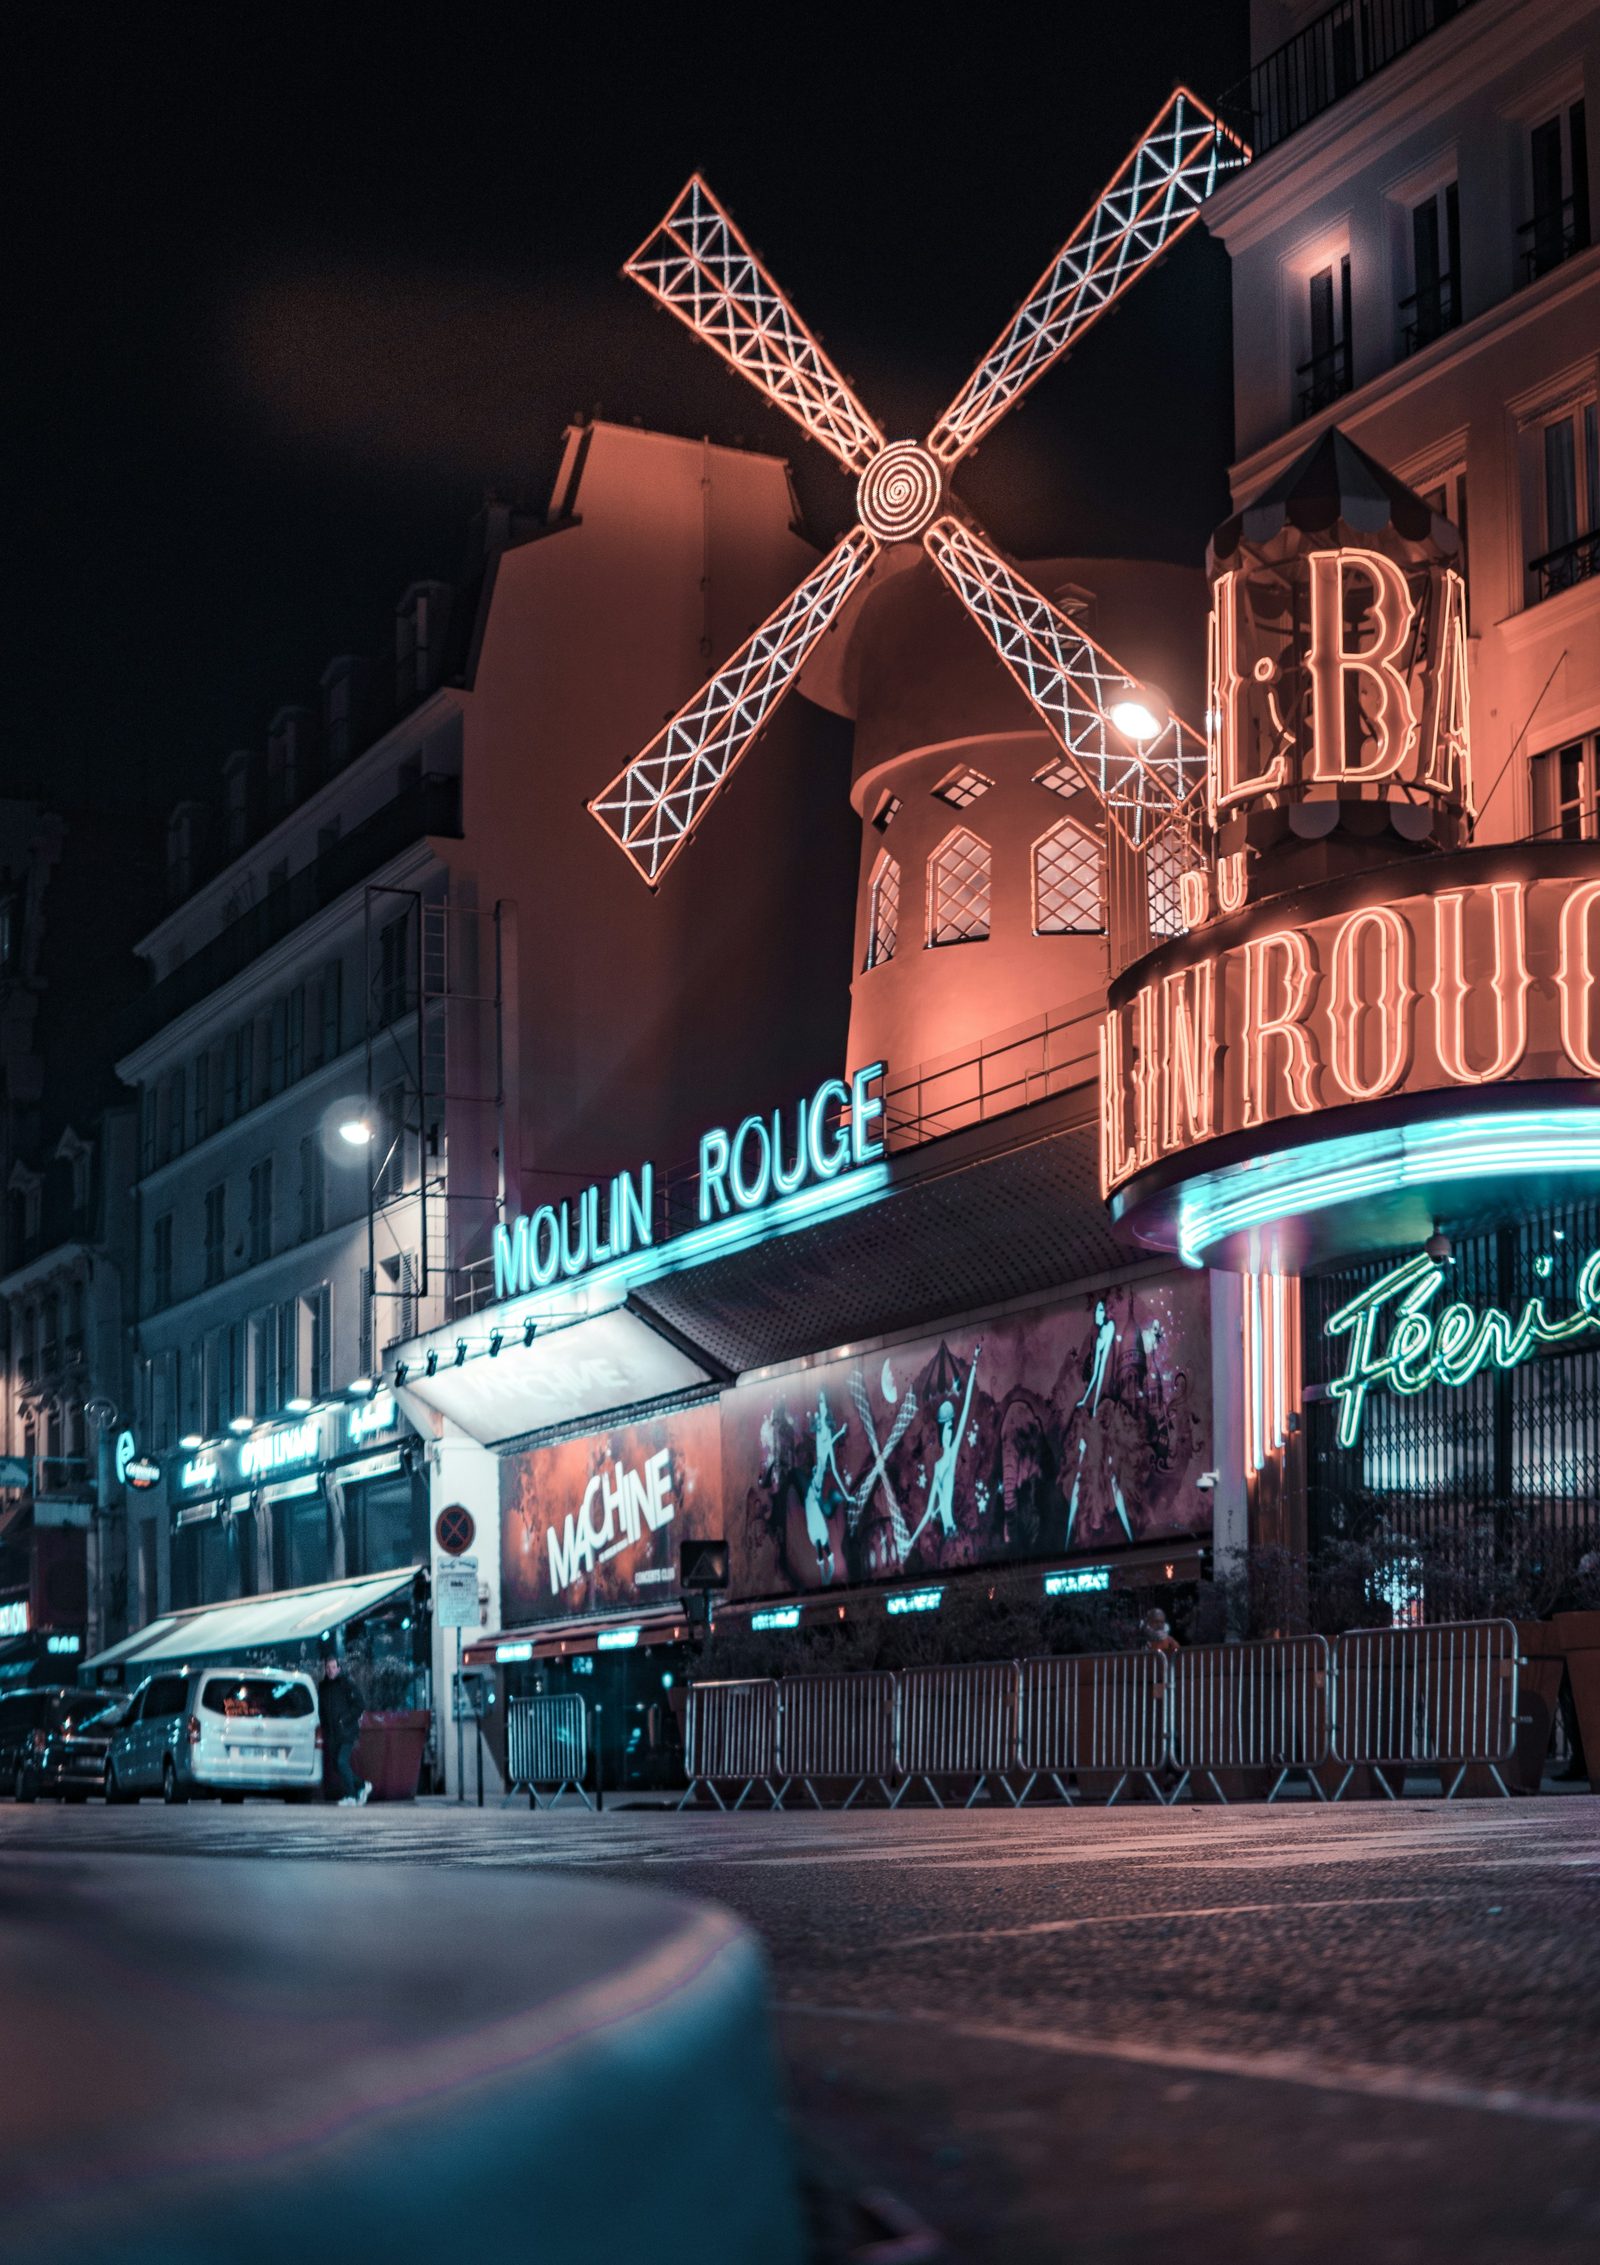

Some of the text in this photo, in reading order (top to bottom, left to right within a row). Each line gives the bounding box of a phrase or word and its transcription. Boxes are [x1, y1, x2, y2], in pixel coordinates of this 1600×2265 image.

[1179, 851, 1249, 930] DU
[1100, 958, 1212, 1200] LIN
[494, 1060, 887, 1299] MOULIN ROUGE
[547, 1447, 676, 1596] MACHINE
